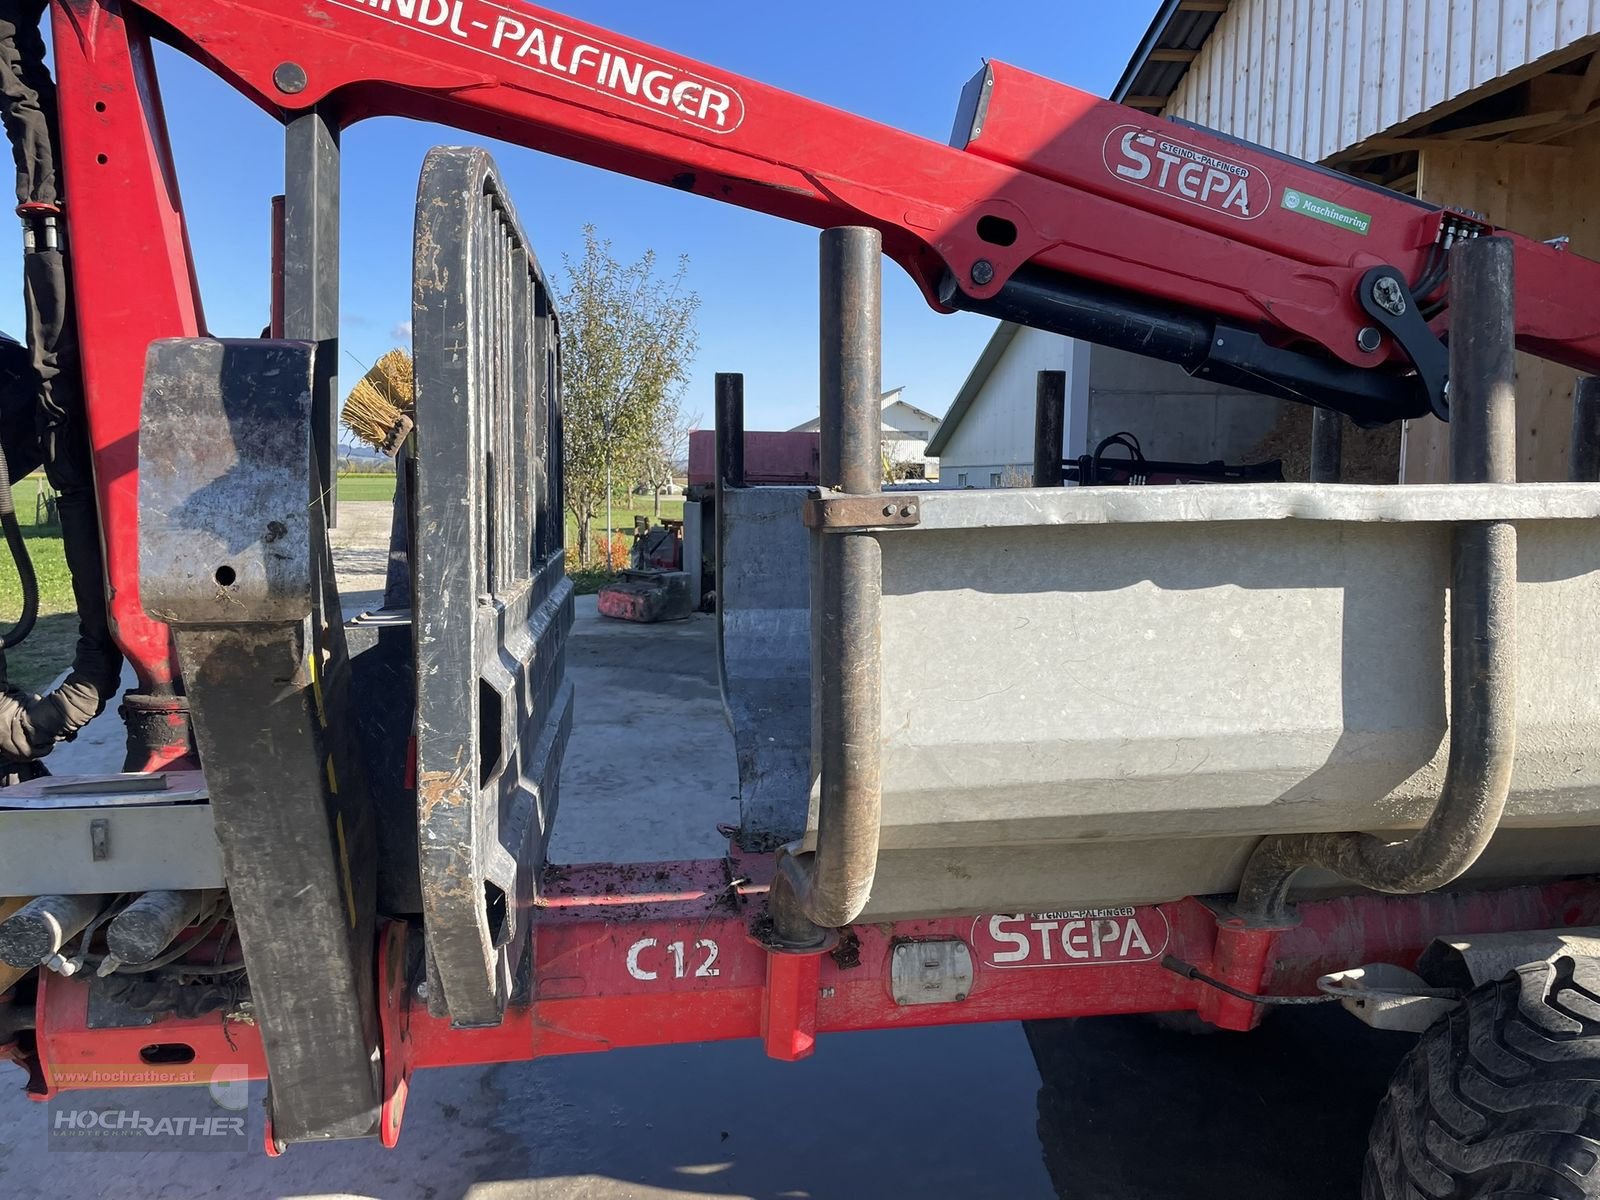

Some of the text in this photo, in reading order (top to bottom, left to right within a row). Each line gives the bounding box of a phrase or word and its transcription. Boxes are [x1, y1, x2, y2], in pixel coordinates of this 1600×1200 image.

[1116, 131, 1249, 216] STEPA
[1162, 142, 1247, 177] STEINDL-PALFINGER
[1303, 200, 1368, 230] Maschinenring
[626, 938, 720, 980] C12
[989, 915, 1152, 963] STEPA
